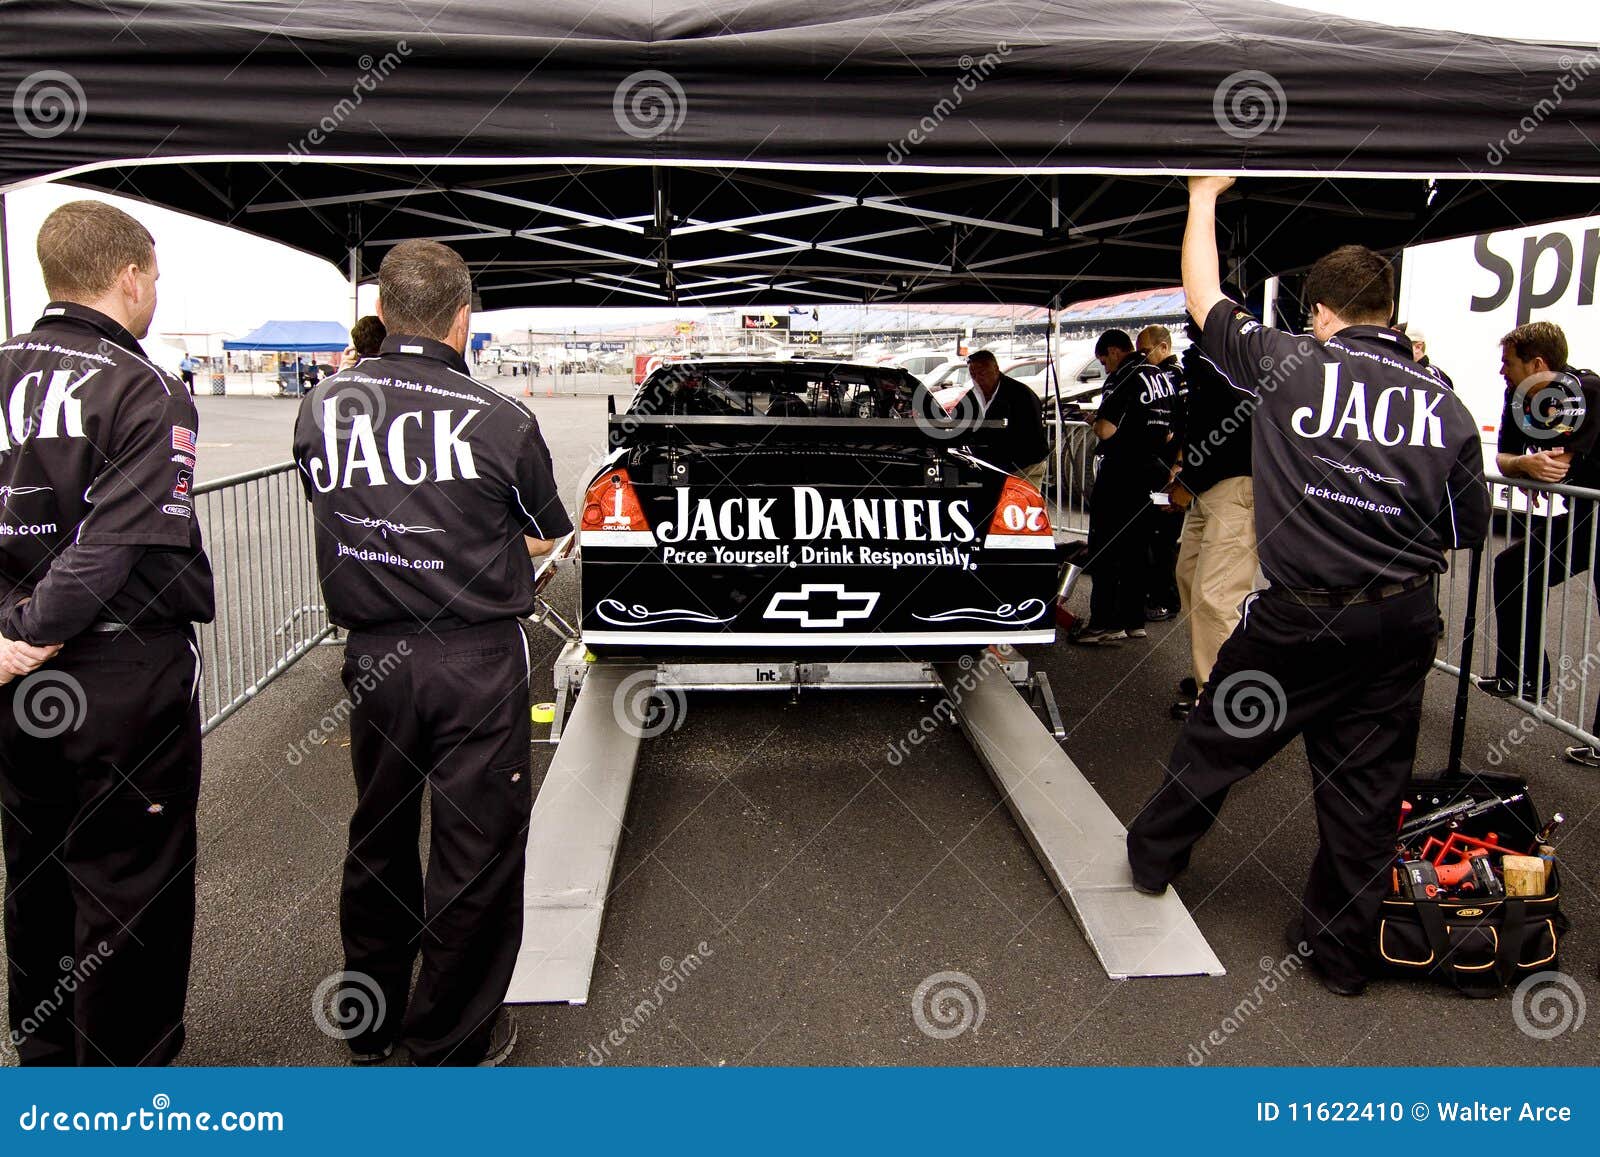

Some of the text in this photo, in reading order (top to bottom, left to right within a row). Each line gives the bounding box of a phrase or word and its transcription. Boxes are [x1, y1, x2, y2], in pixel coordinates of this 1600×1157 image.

[394, 378, 423, 392] Drink
[1290, 362, 1449, 449] JACK
[309, 396, 482, 493] JACK
[656, 486, 778, 543] JACK
[663, 546, 707, 564] Pace
[801, 545, 855, 564] Drink
